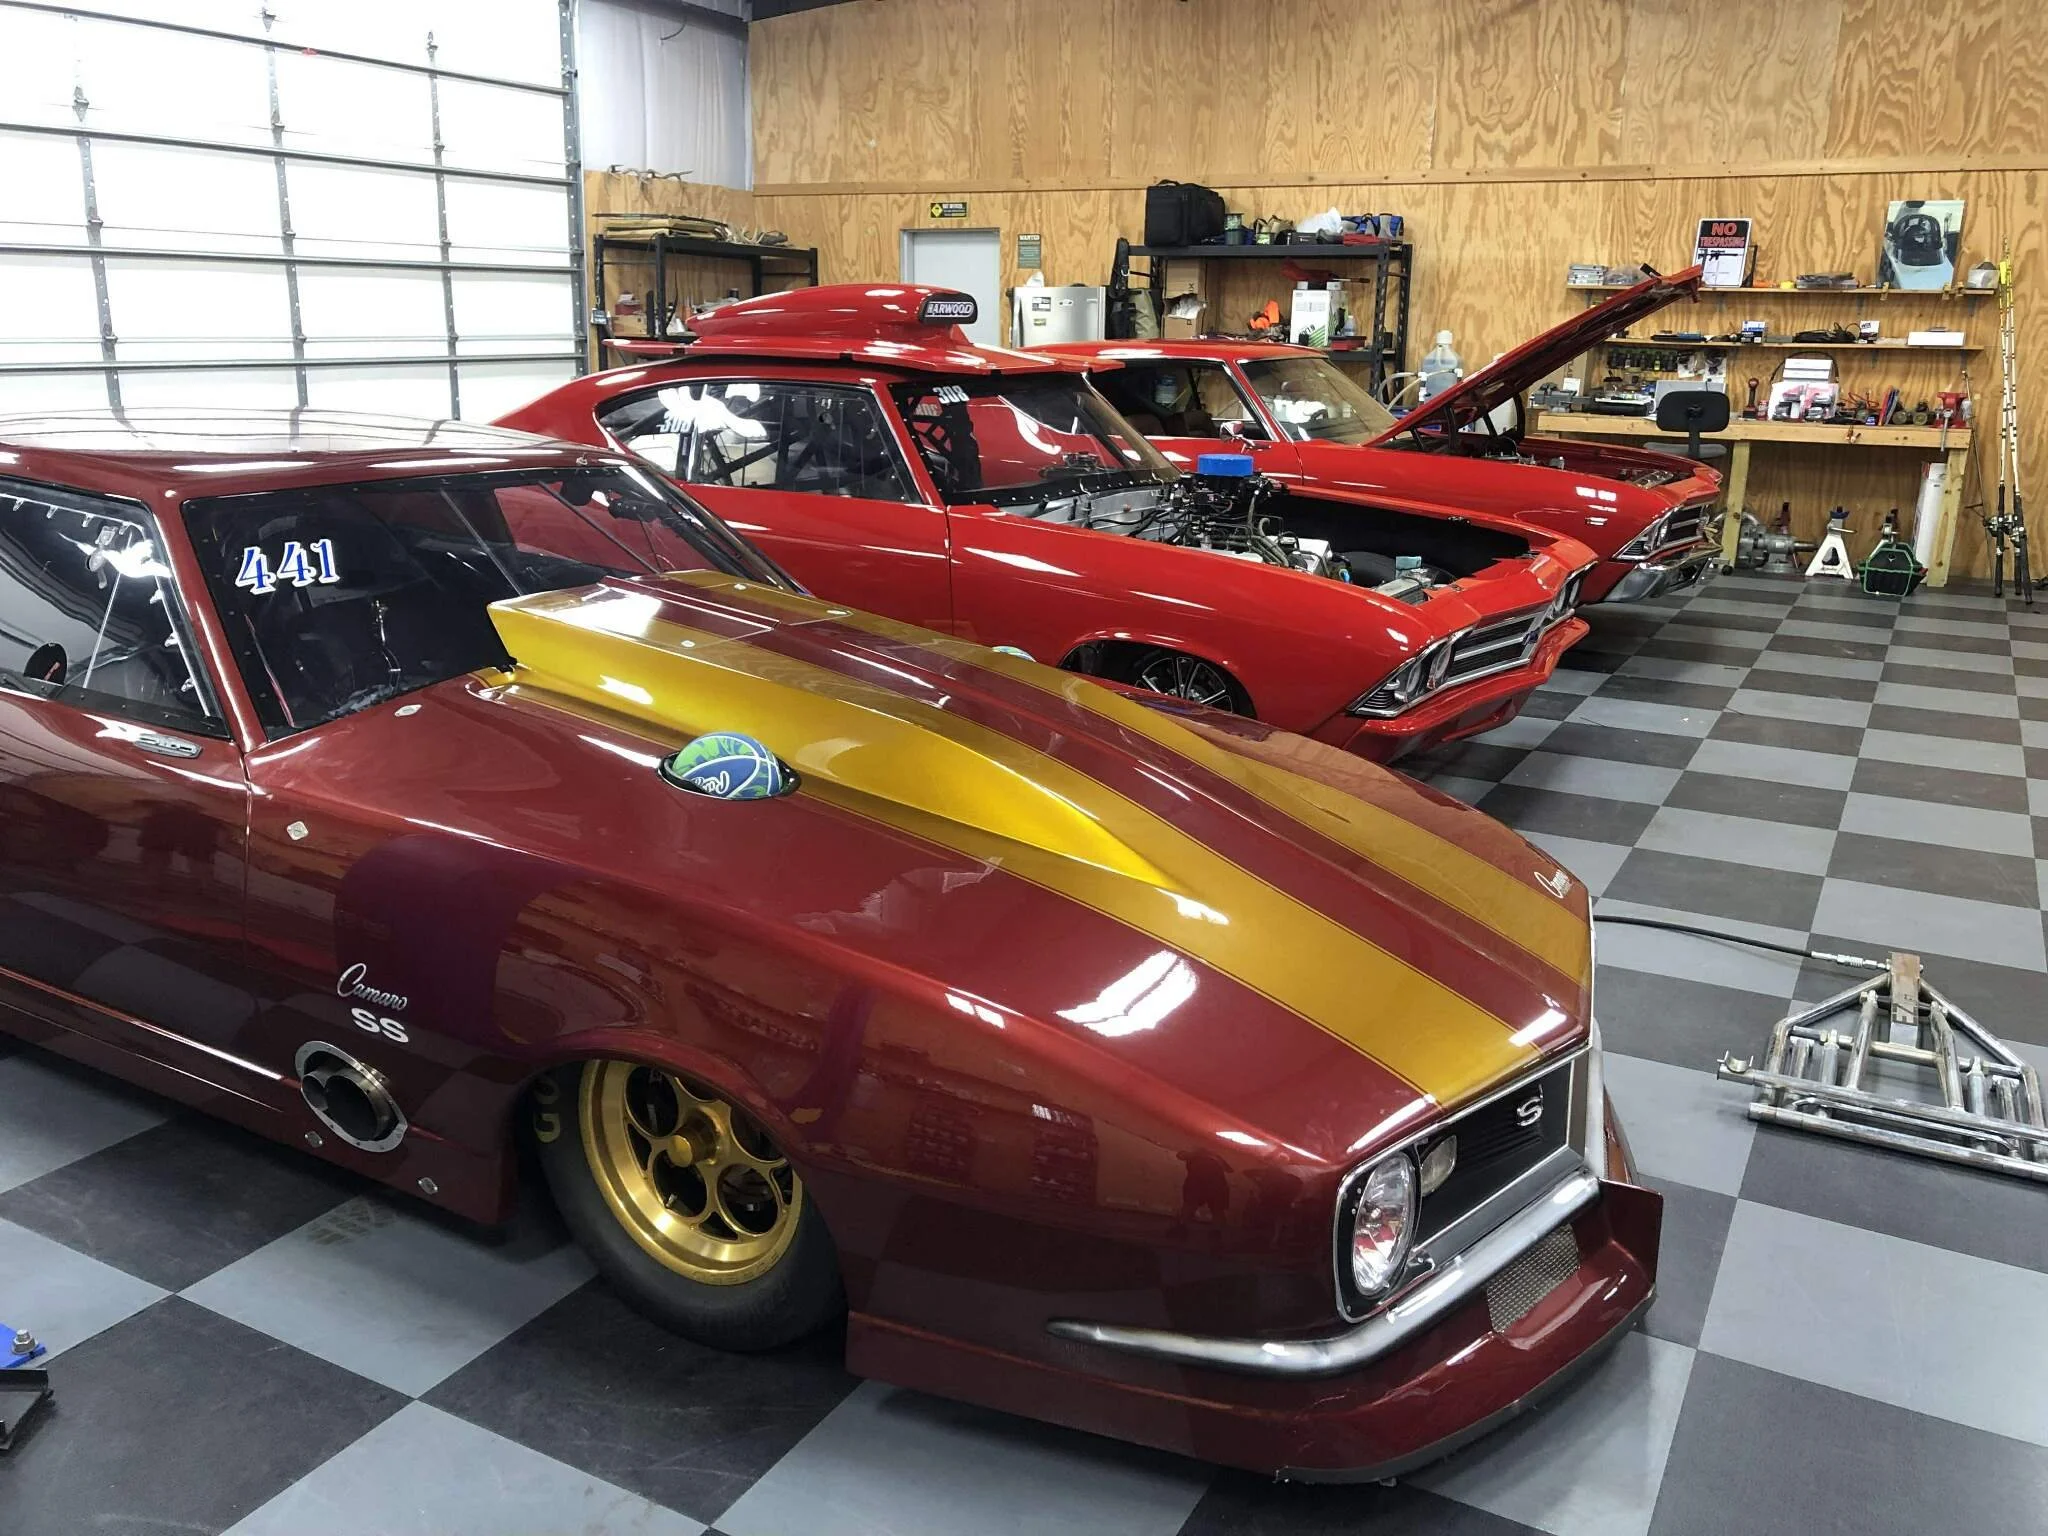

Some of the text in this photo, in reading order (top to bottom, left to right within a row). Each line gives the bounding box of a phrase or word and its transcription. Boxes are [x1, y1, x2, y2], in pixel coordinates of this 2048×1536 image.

[1711, 222, 1738, 236] NO
[927, 303, 972, 314] HARWOOD
[932, 385, 970, 404] 308
[235, 538, 340, 595] 441
[336, 962, 408, 1011] Camaro
[351, 1007, 409, 1043] SS
